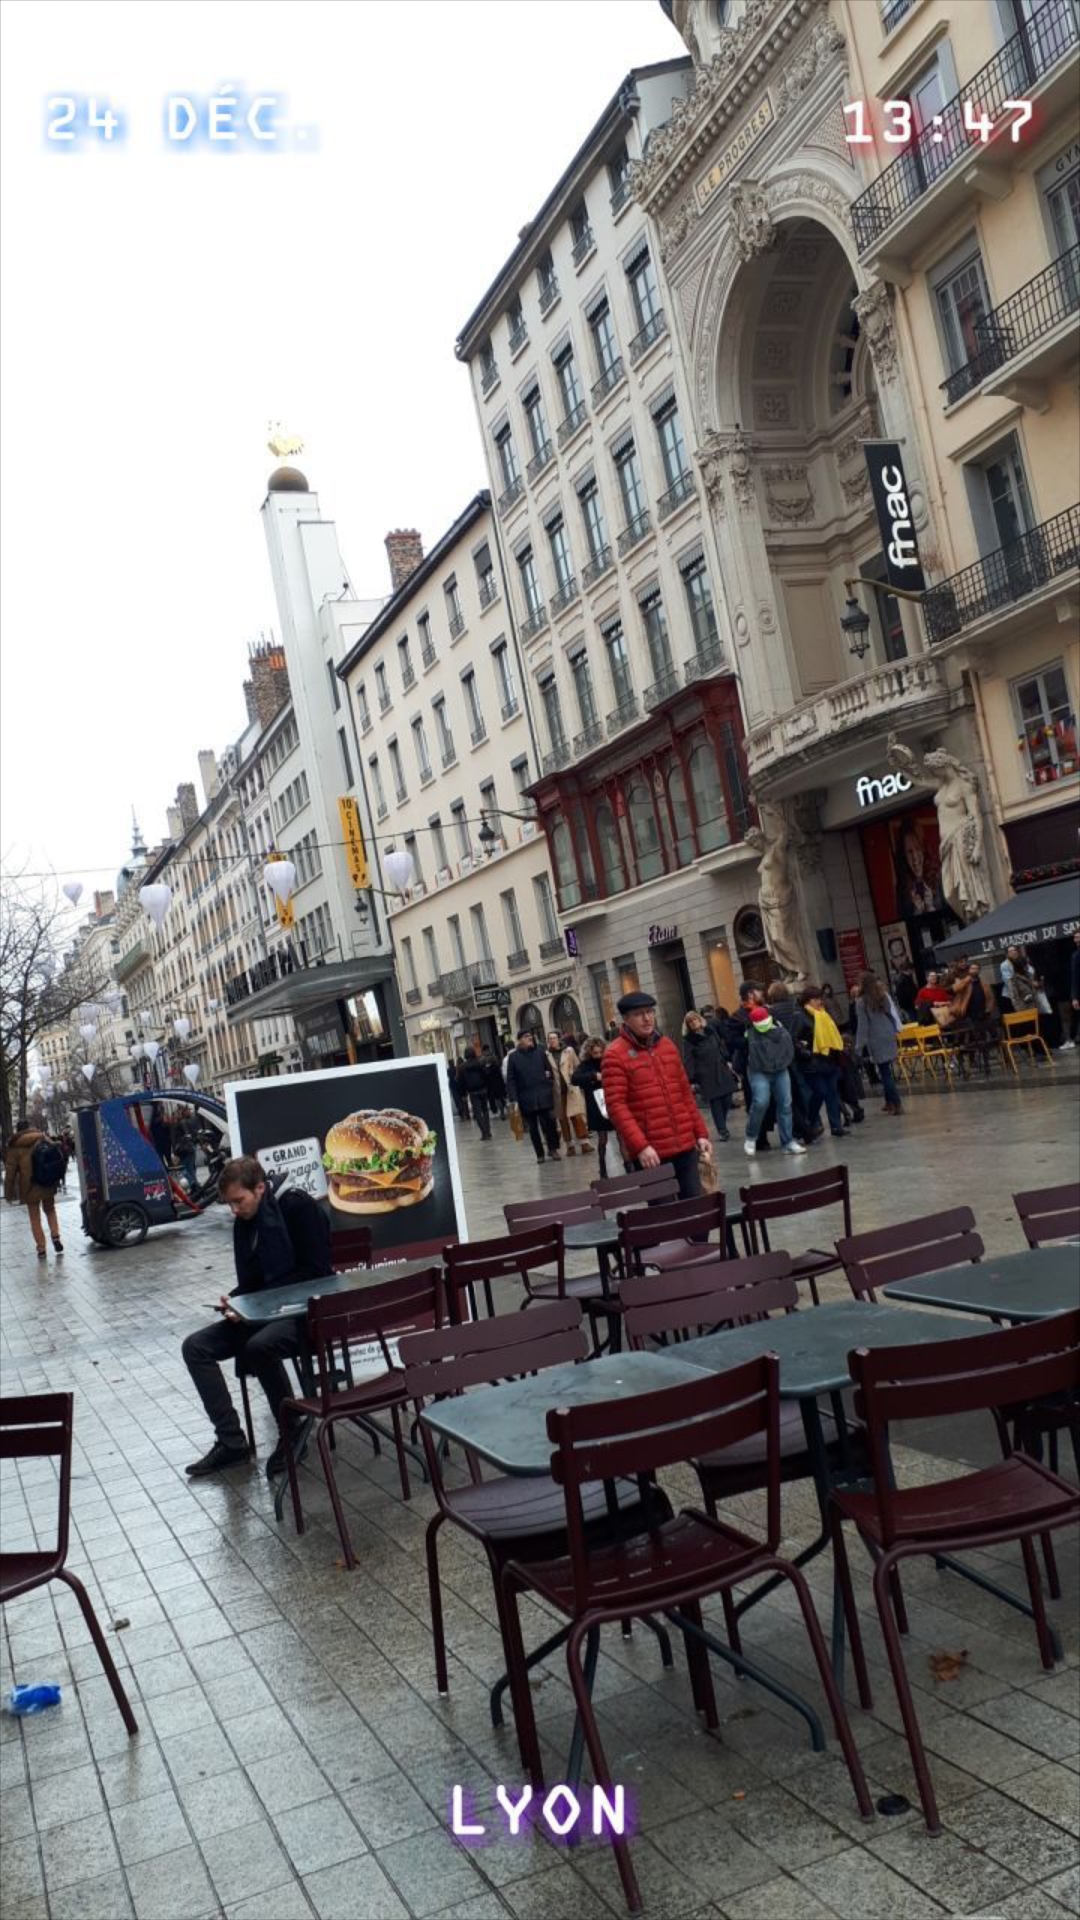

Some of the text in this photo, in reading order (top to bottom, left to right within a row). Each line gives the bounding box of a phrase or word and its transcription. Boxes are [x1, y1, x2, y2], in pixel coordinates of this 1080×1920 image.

[881, 465, 918, 569] fnac
[856, 772, 912, 807] fnac
[341, 798, 352, 809] 10
[982, 940, 996, 952] LA
[999, 930, 1037, 949] MAISON
[1042, 925, 1057, 940] DU
[527, 986, 540, 999] THE
[556, 976, 572, 992] SHOP
[272, 1145, 307, 1163] GRAND
